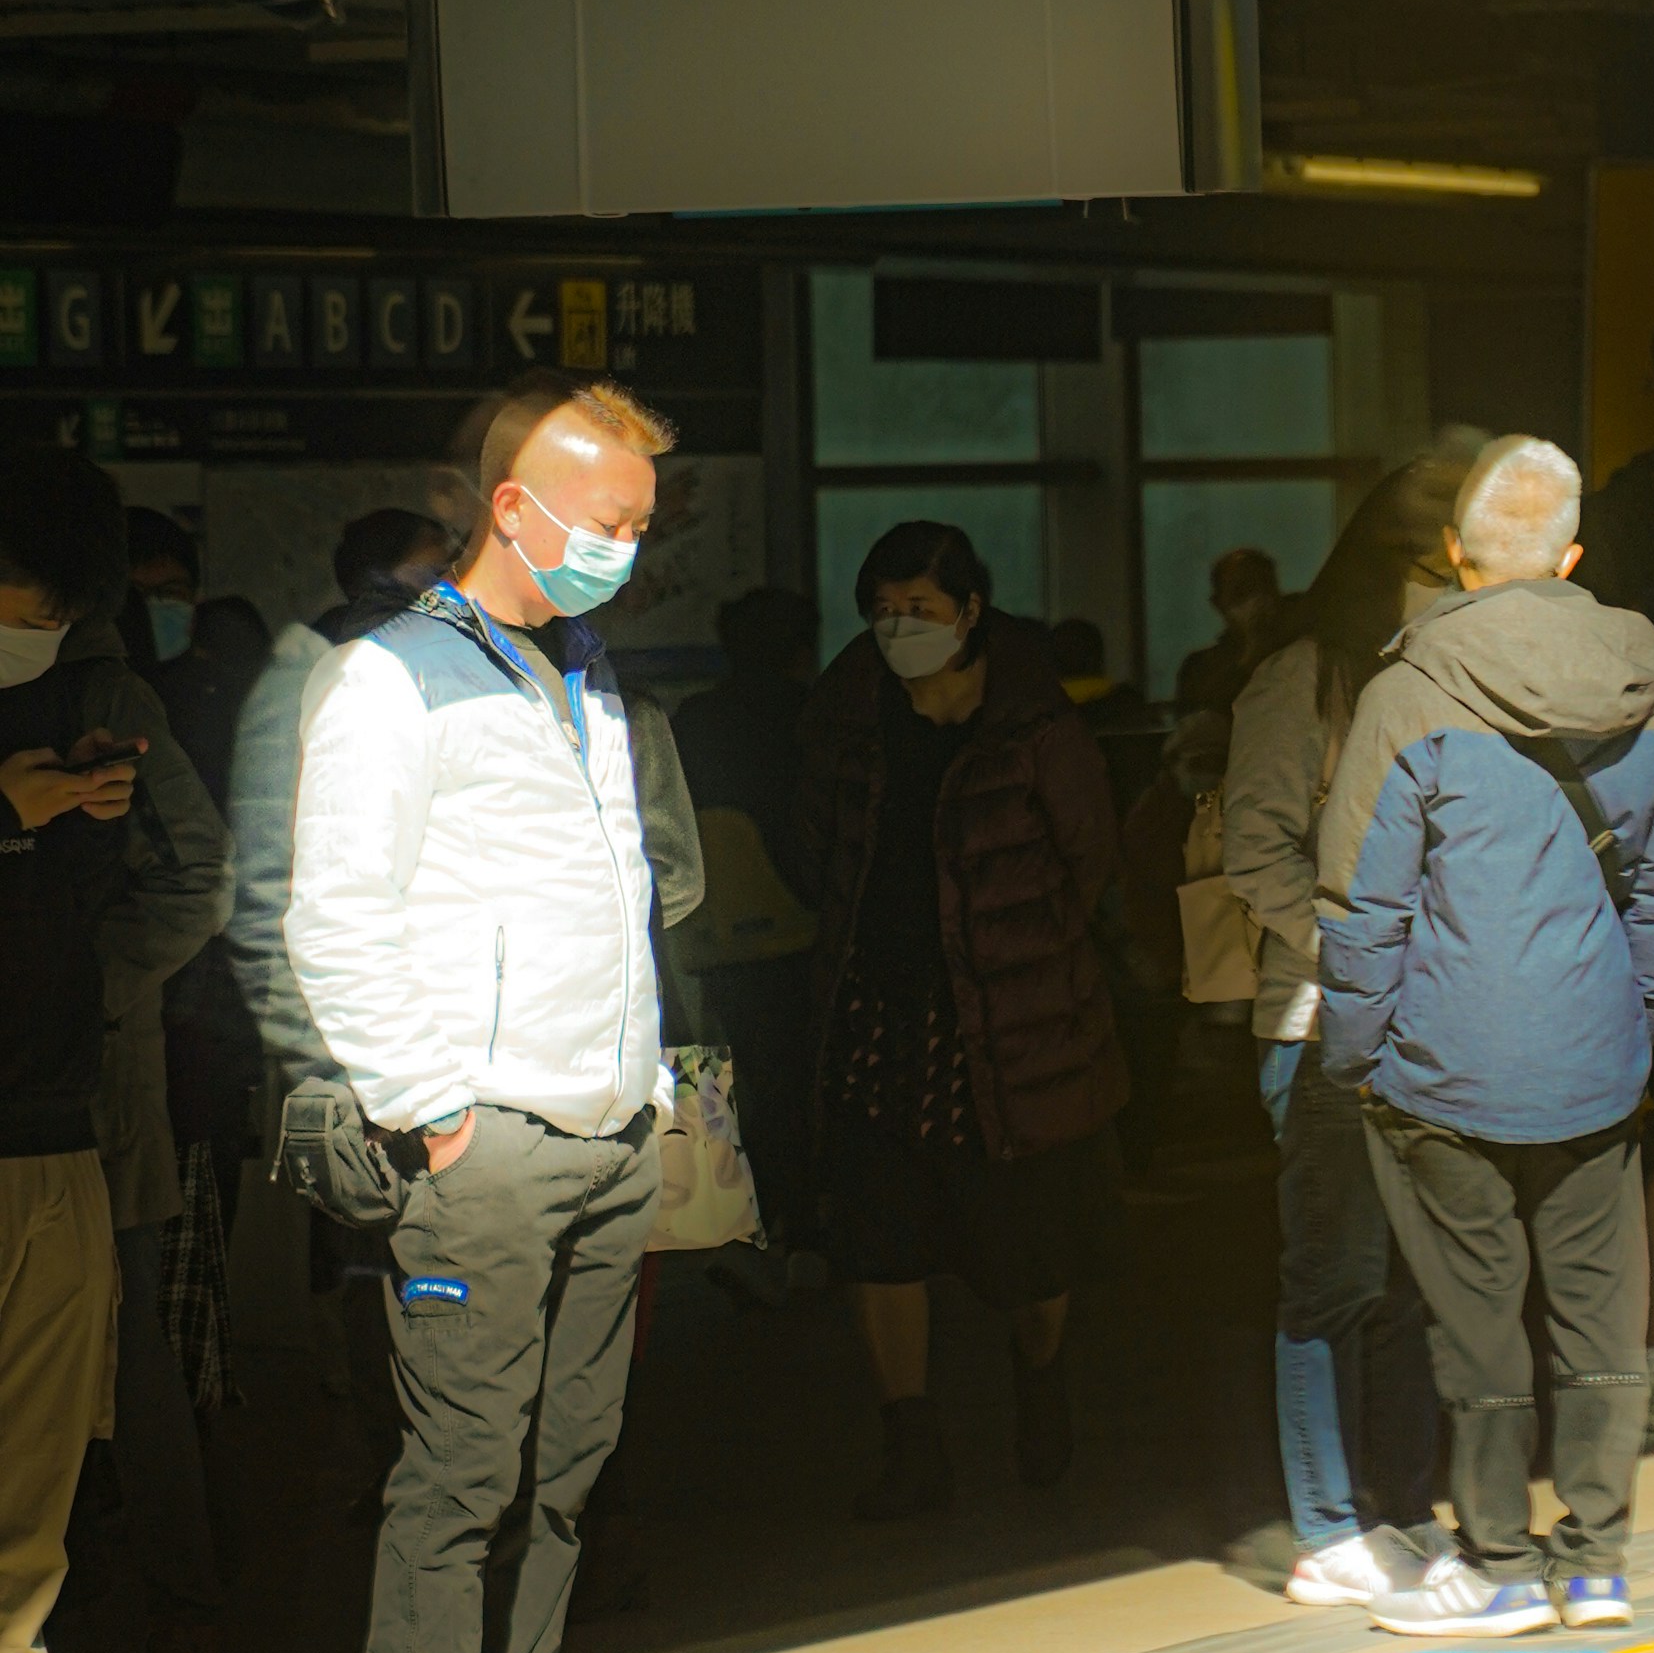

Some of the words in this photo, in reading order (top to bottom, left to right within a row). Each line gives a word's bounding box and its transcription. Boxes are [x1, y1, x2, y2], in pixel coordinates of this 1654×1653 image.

[60, 284, 91, 351] G
[264, 289, 293, 353] A
[324, 289, 349, 354] B
[379, 292, 406, 353] C
[434, 293, 463, 354] D
